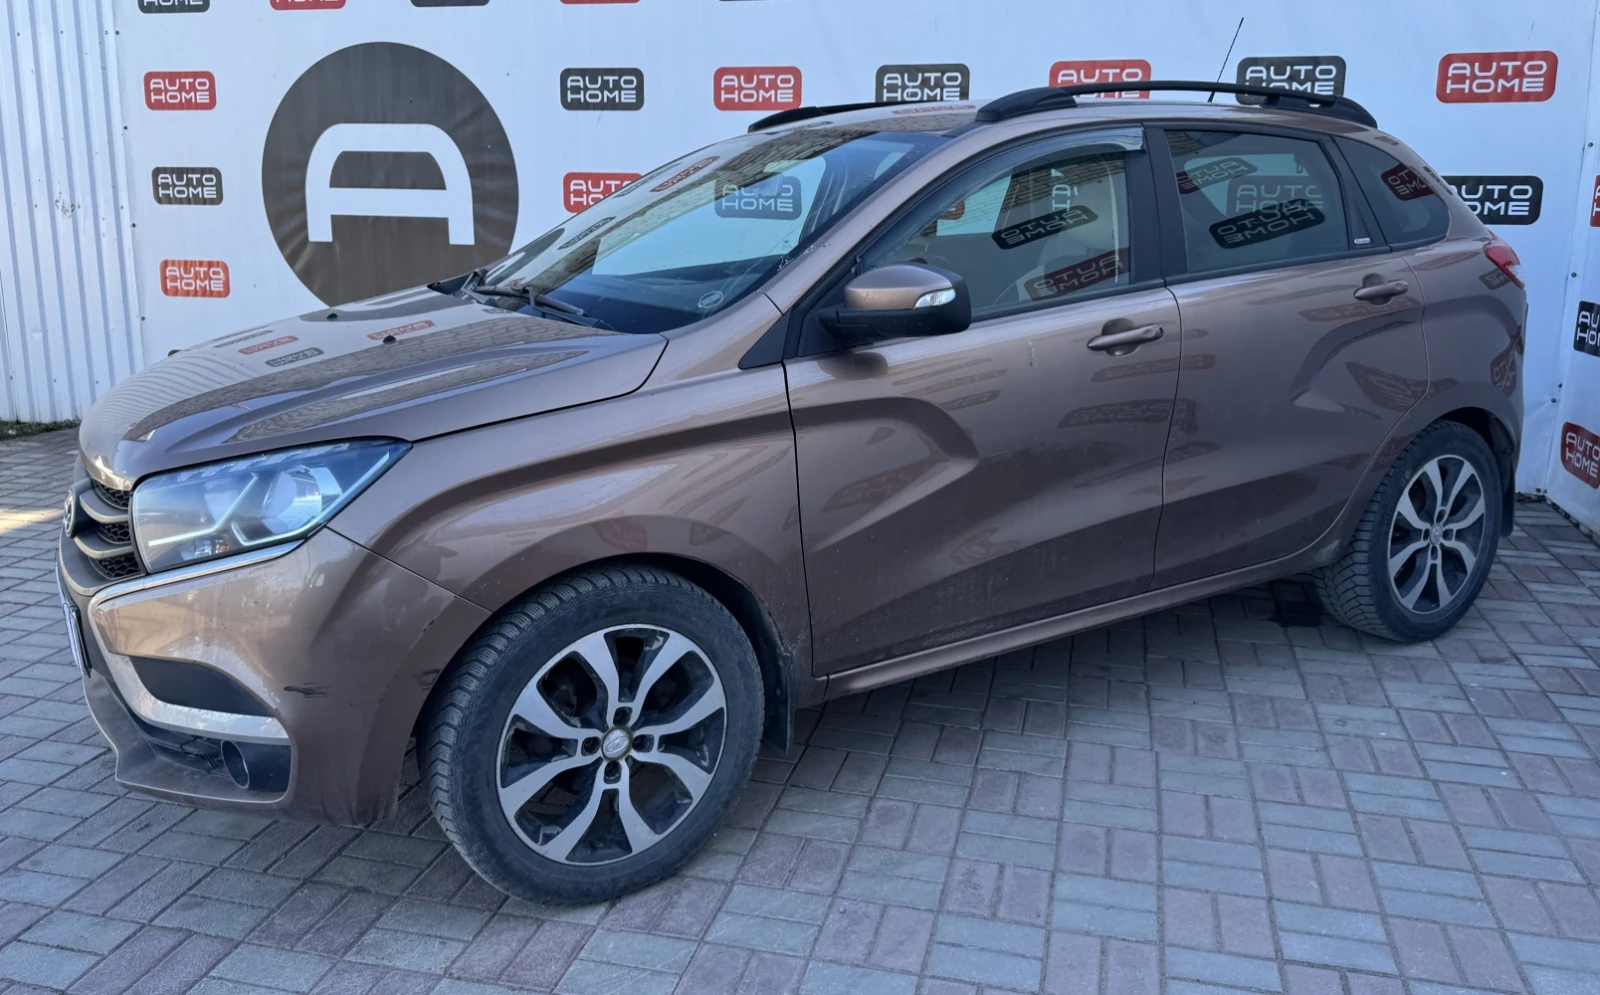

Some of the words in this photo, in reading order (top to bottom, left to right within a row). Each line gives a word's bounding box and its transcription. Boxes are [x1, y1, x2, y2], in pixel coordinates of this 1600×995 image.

[1245, 65, 1337, 80] AUTO
[1447, 60, 1548, 77] AUTO
[566, 75, 638, 88] AUTO
[720, 75, 795, 88] AUTO
[883, 72, 962, 87] AUTO
[1057, 68, 1143, 84] AUTO
[150, 78, 210, 90] AUTO
[1446, 77, 1546, 93] HOME
[150, 91, 210, 103] HOME
[566, 89, 637, 103] HOME
[720, 89, 794, 103] HOME
[883, 87, 961, 102] HOME
[158, 173, 217, 186] AUTO
[569, 179, 632, 193] AUT
[158, 186, 217, 199] HOME
[721, 184, 794, 197] AUO
[721, 198, 794, 212] HOME
[1463, 201, 1530, 216] OME
[165, 265, 225, 280] AUTO
[166, 278, 225, 292] HOME
[1578, 311, 1600, 328] AU
[1576, 327, 1600, 346] HO
[1566, 431, 1600, 462] AUTO
[1565, 447, 1599, 478] HOME
